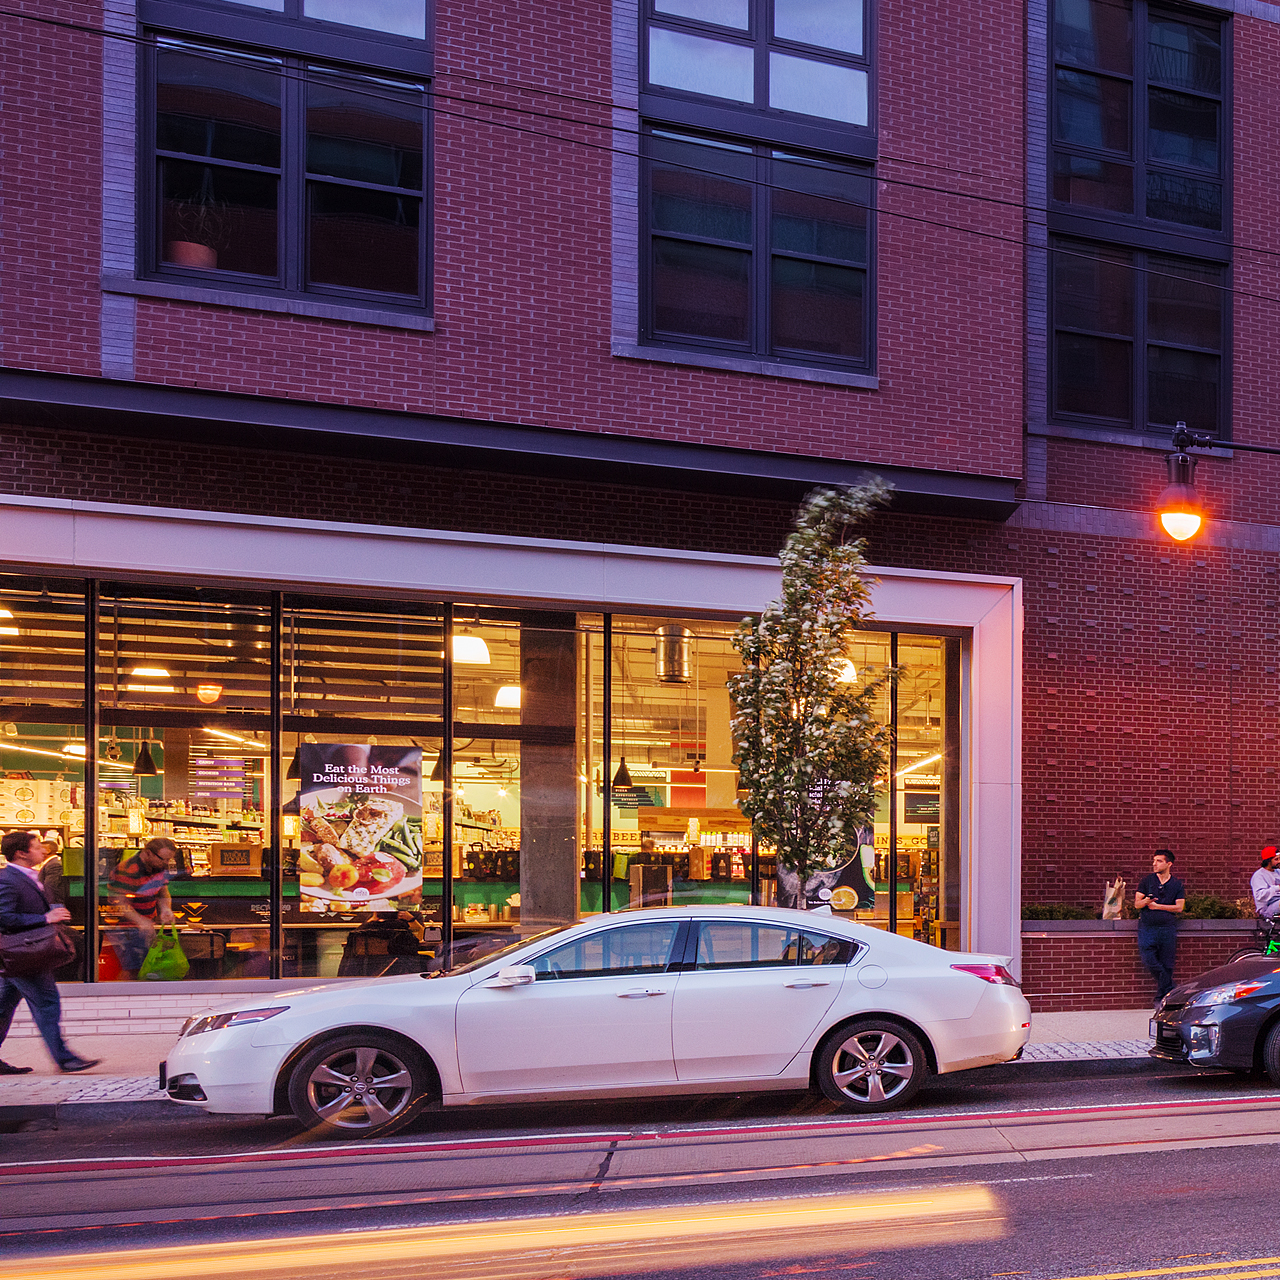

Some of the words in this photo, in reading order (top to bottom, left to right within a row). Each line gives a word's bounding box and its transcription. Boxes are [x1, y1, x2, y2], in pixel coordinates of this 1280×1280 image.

[325, 763, 345, 773] Eat
[348, 764, 367, 774] the
[371, 765, 399, 775] Most
[313, 773, 368, 783] Delicious
[371, 775, 410, 786] Things
[355, 785, 387, 794] Earth
